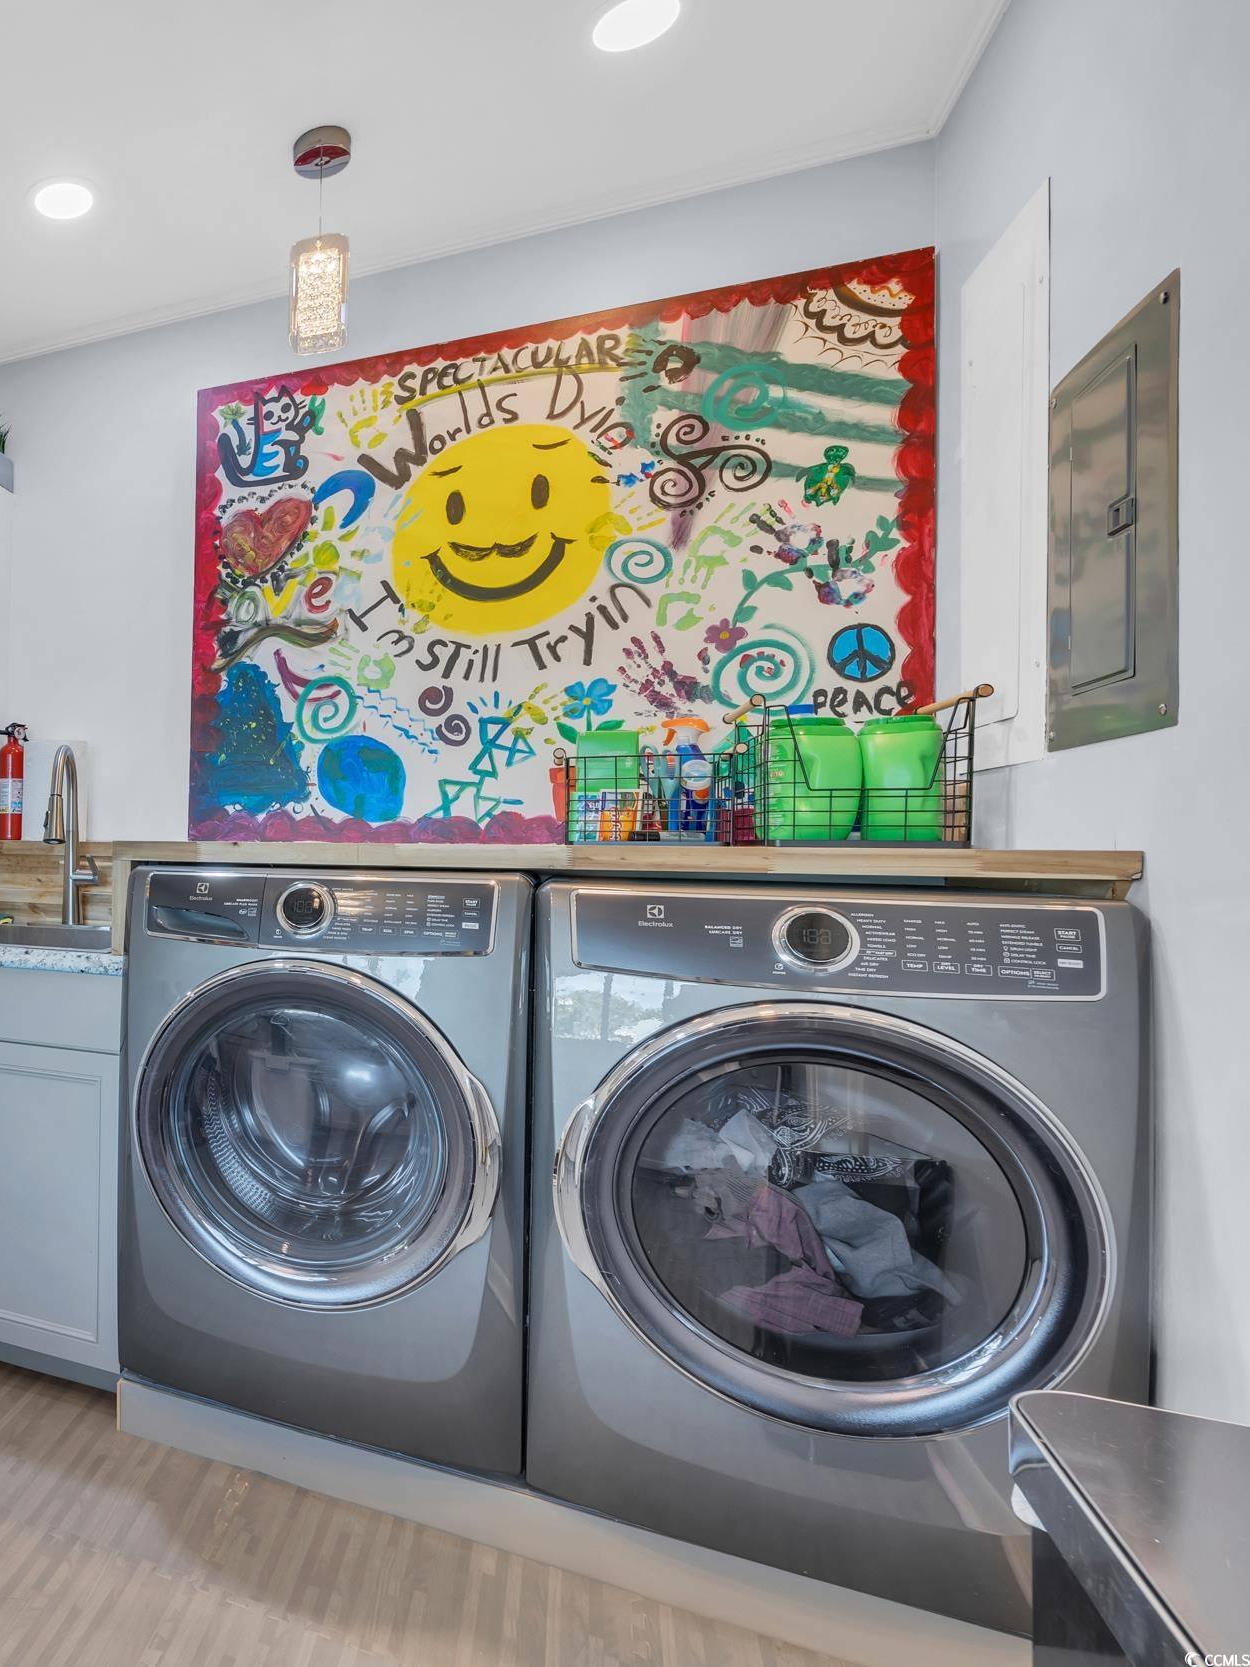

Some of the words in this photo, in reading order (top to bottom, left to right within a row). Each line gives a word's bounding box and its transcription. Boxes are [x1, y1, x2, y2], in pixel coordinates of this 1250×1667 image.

[394, 334, 625, 406] SPECTACULAR
[510, 582, 652, 671] Tryin
[638, 920, 674, 928] Electrolux
